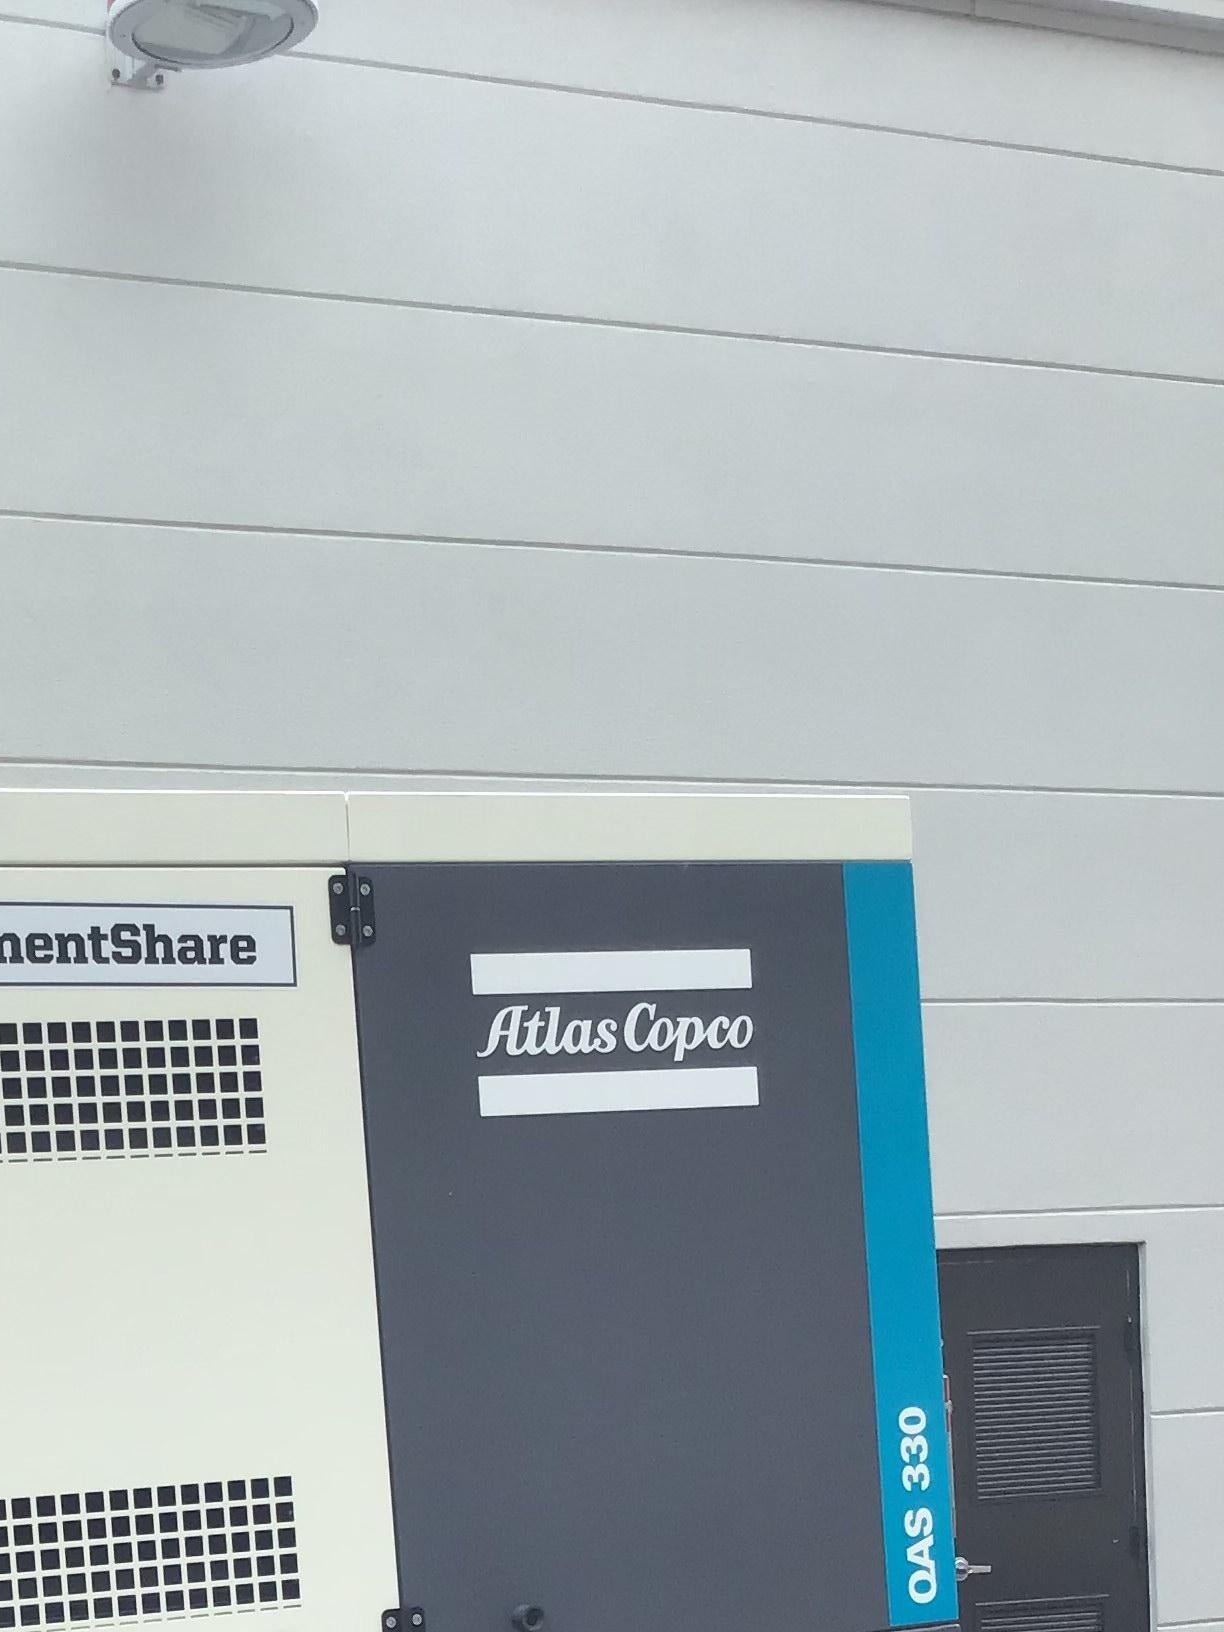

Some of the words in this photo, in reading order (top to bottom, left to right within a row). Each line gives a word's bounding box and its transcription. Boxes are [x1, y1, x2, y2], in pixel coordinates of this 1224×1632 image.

[476, 1004, 618, 1058] Atlas
[623, 1002, 754, 1062] Copco
[898, 1406, 931, 1492] 330
[904, 1507, 937, 1604] QAS
